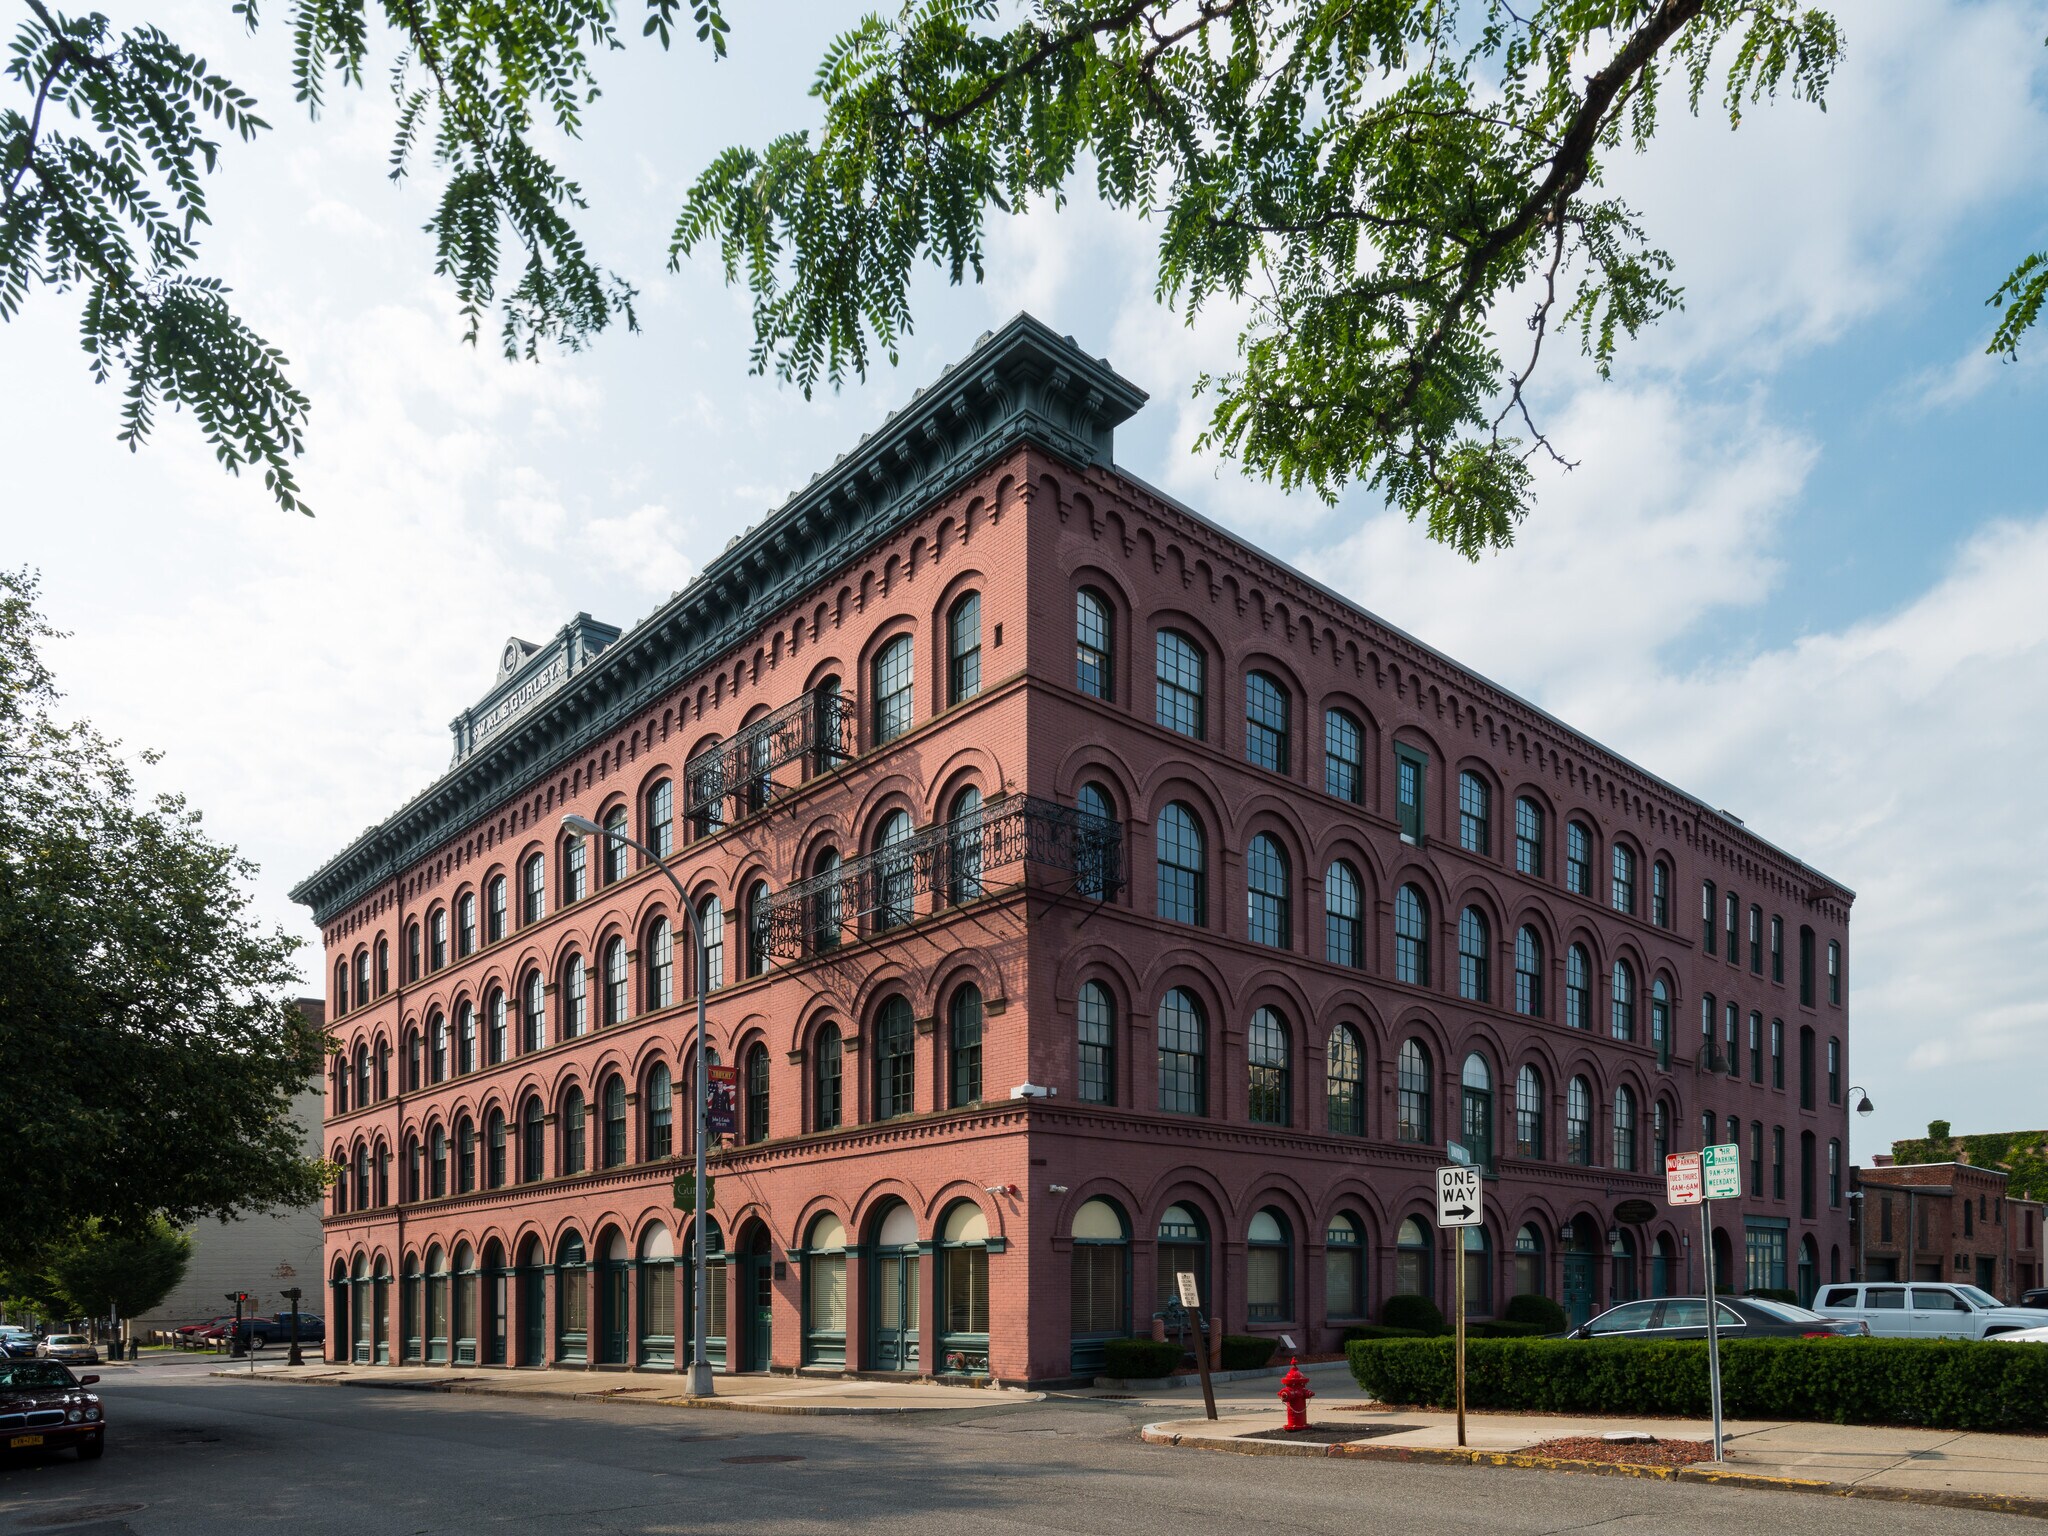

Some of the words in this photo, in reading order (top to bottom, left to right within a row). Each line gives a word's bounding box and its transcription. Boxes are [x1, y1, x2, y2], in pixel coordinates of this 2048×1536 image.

[1667, 1158, 1677, 1169] NO
[1677, 1158, 1698, 1167] PARKING
[1705, 1150, 1714, 1164] 2
[1715, 1156, 1736, 1164] PARKING
[1443, 1170, 1476, 1186] ONE
[1708, 1177, 1737, 1187] WEEKDAYS
[677, 1183, 712, 1199] Gury
[1443, 1187, 1476, 1203] WAY
